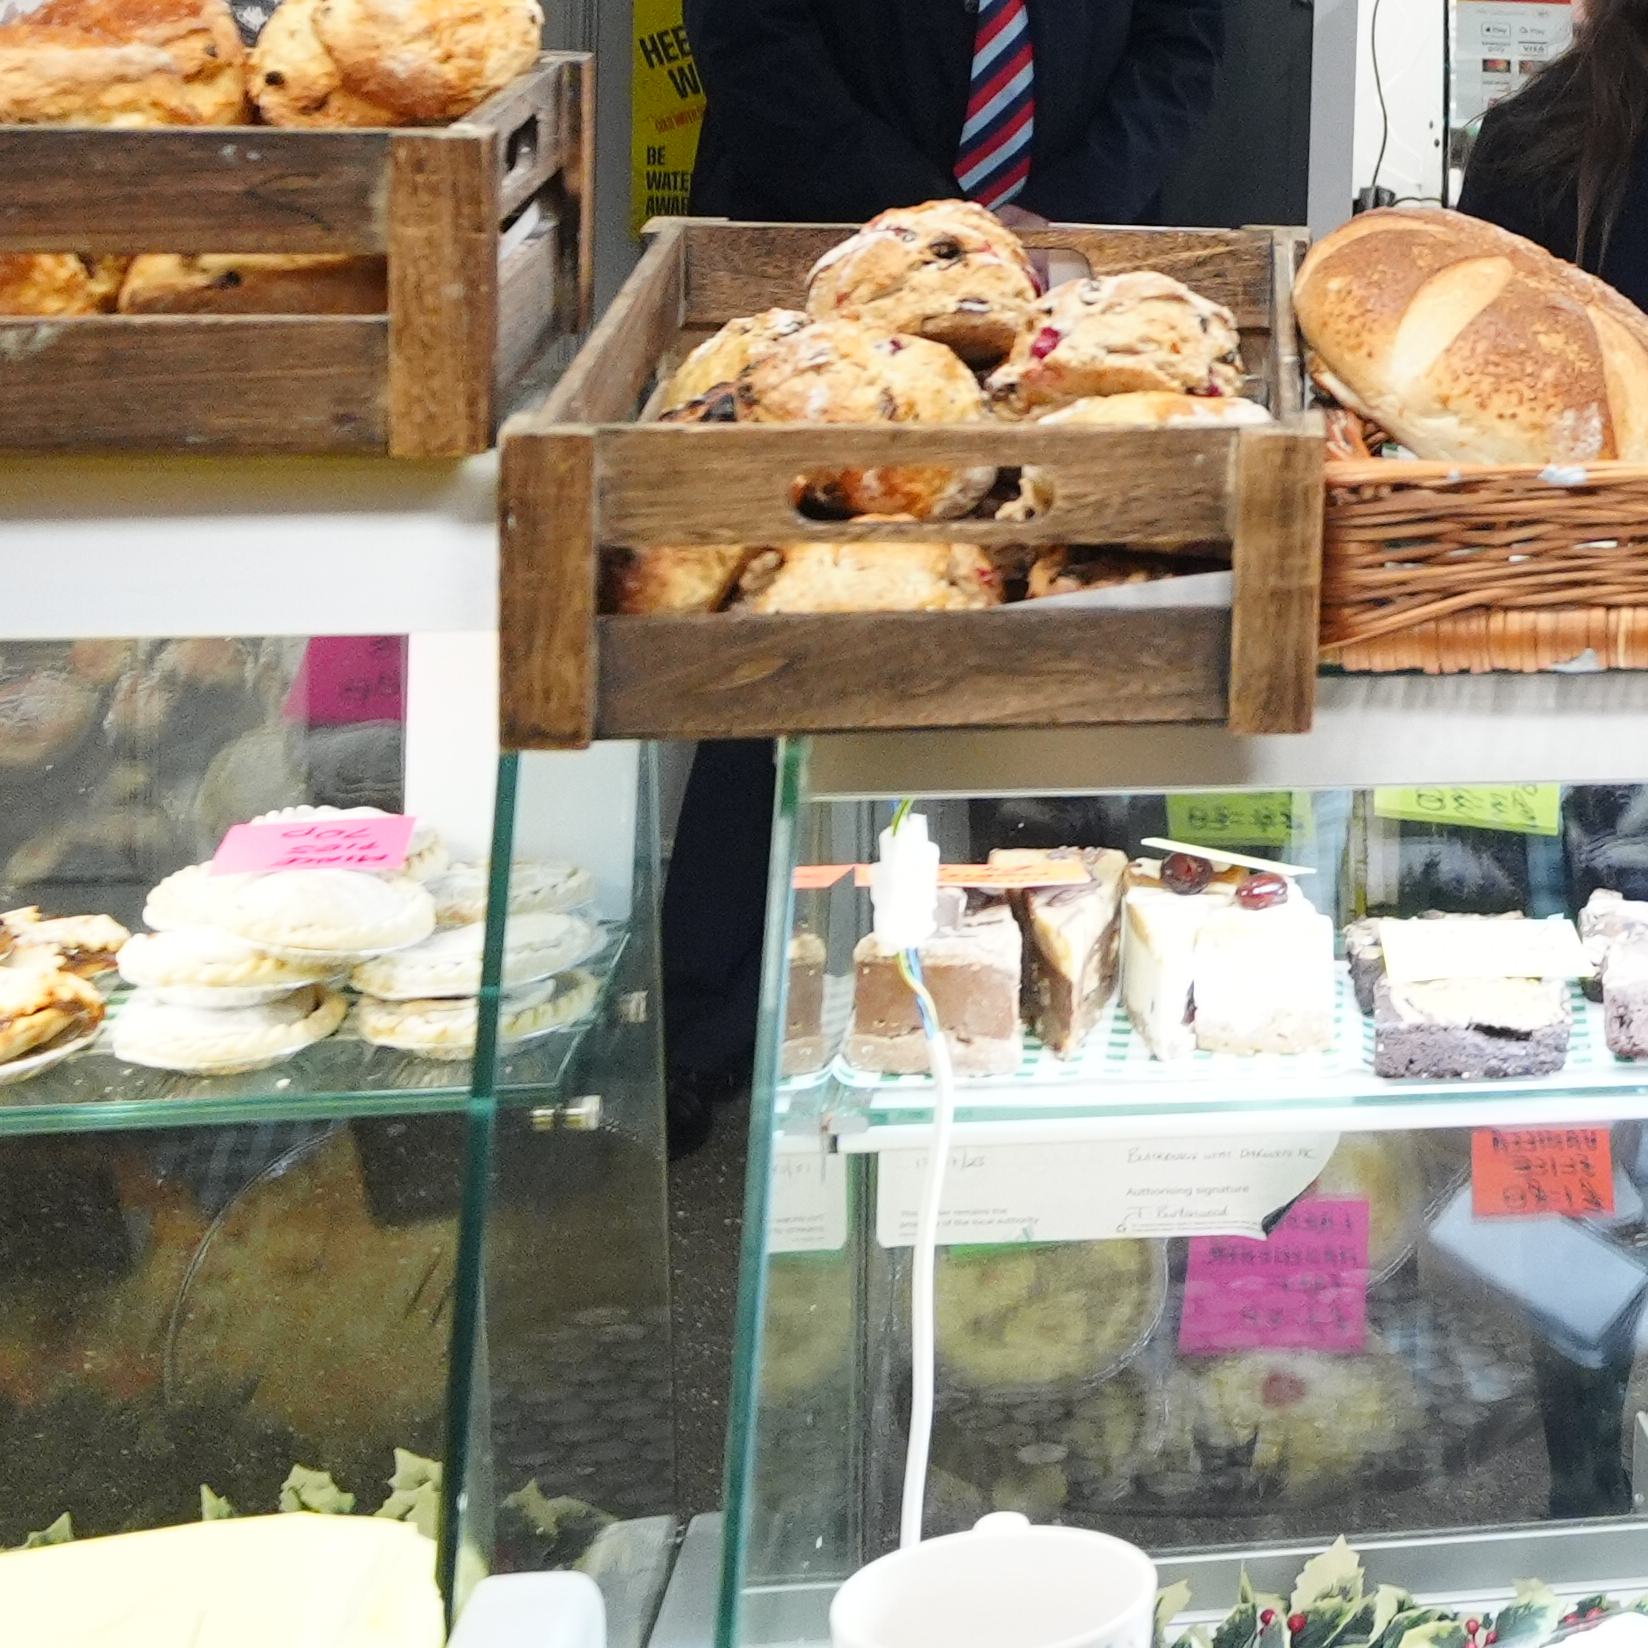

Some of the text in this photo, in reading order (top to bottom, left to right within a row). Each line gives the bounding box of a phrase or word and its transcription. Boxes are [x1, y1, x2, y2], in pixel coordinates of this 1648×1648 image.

[646, 145, 667, 166] BE
[645, 170, 690, 192] WATE
[1126, 1182, 1250, 1197] Authorising signature
